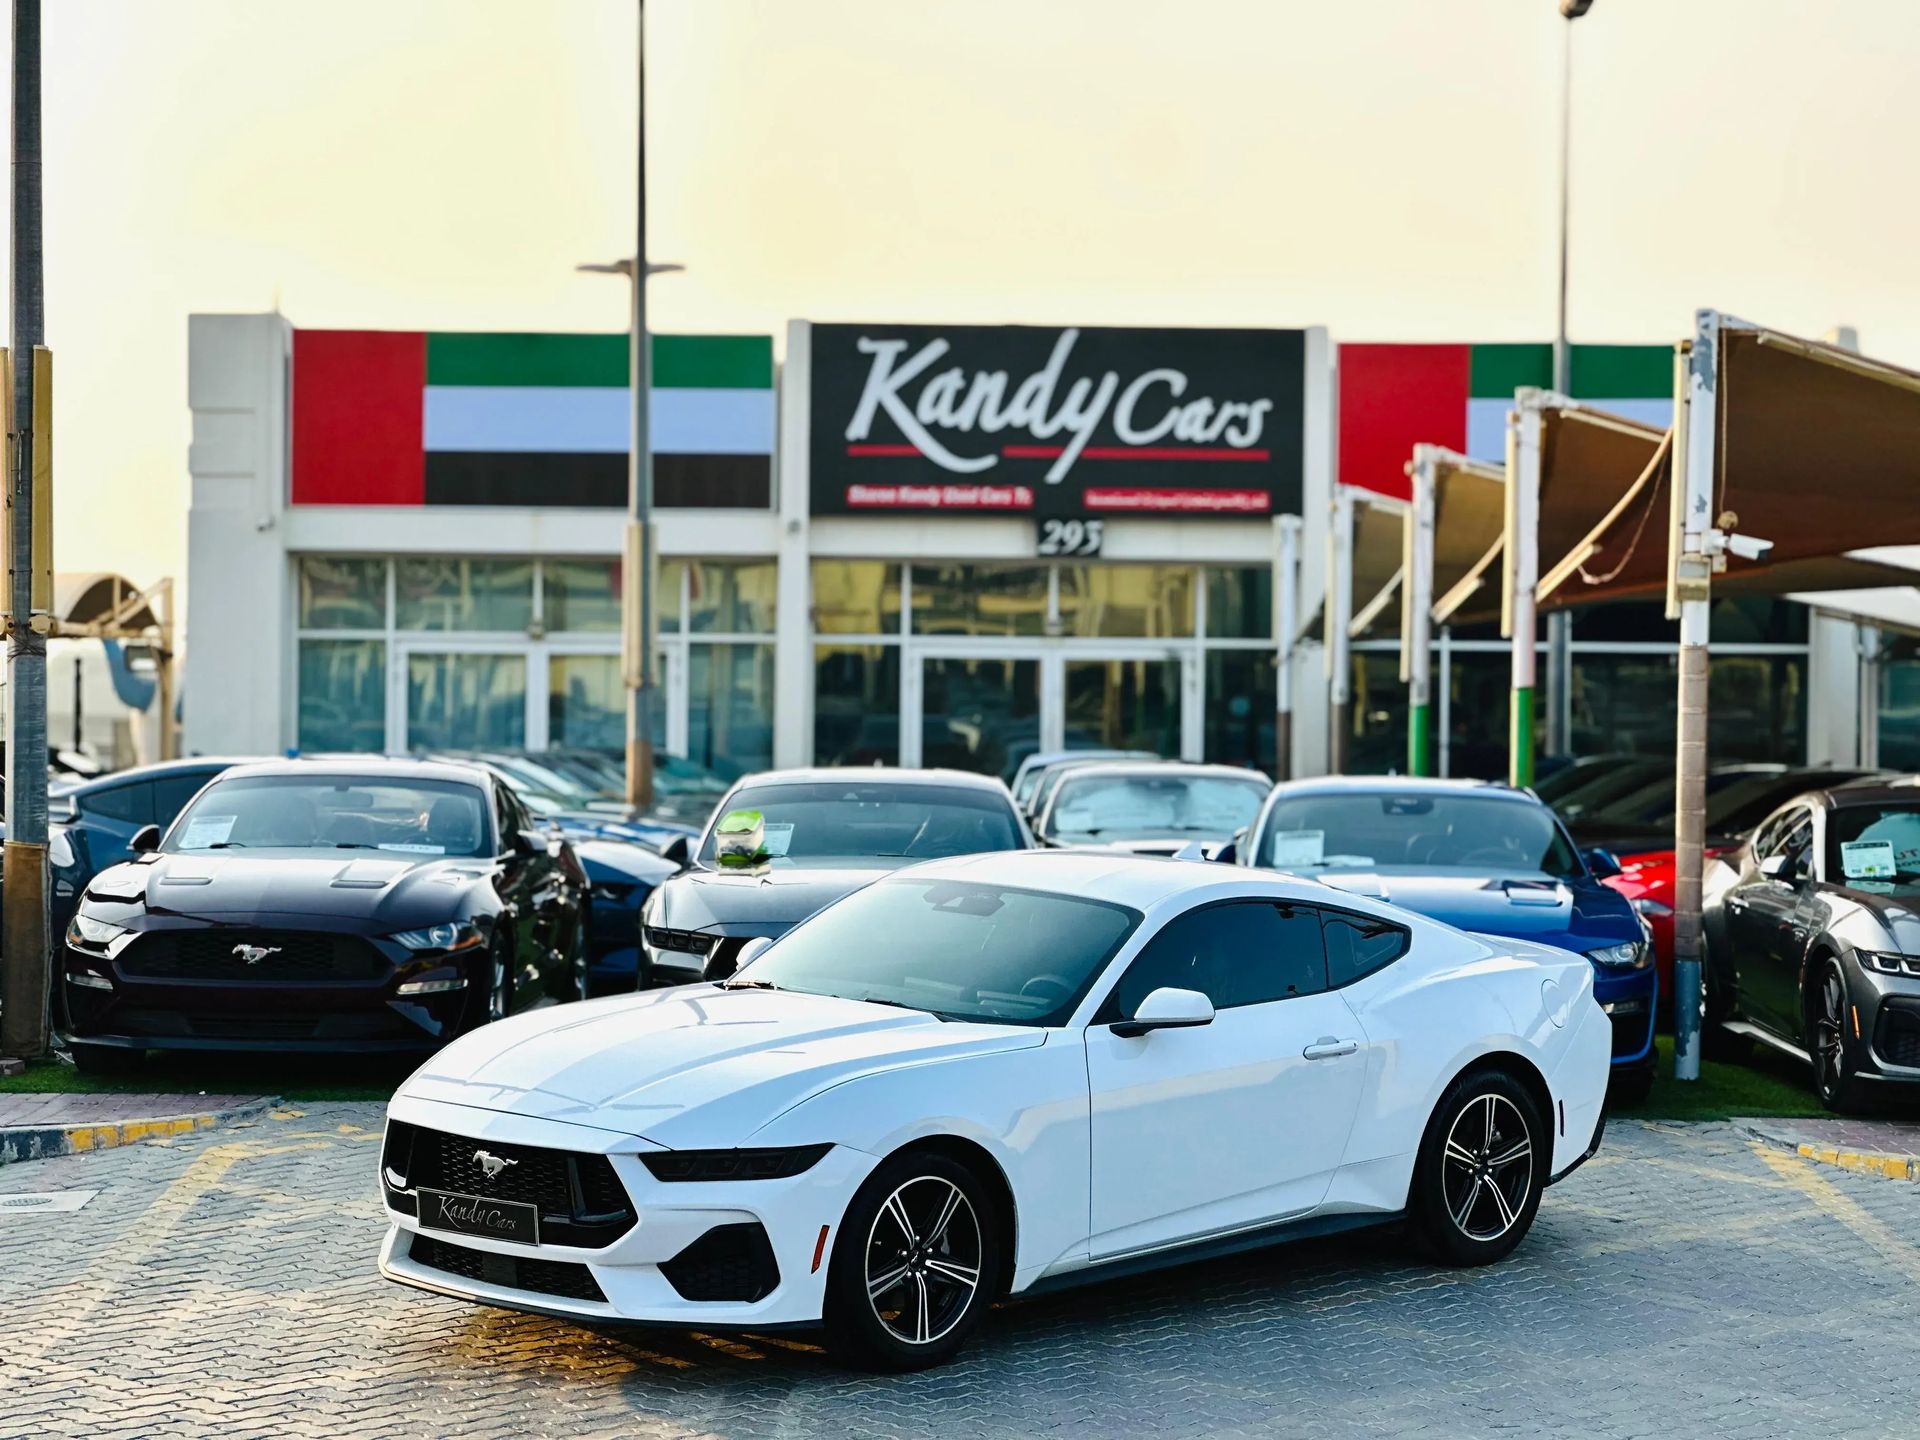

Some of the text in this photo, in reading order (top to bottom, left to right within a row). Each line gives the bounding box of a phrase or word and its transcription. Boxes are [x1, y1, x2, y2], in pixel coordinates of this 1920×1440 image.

[845, 328, 1273, 484] Kandy Cars
[438, 1195, 517, 1230] Kandy Cars
